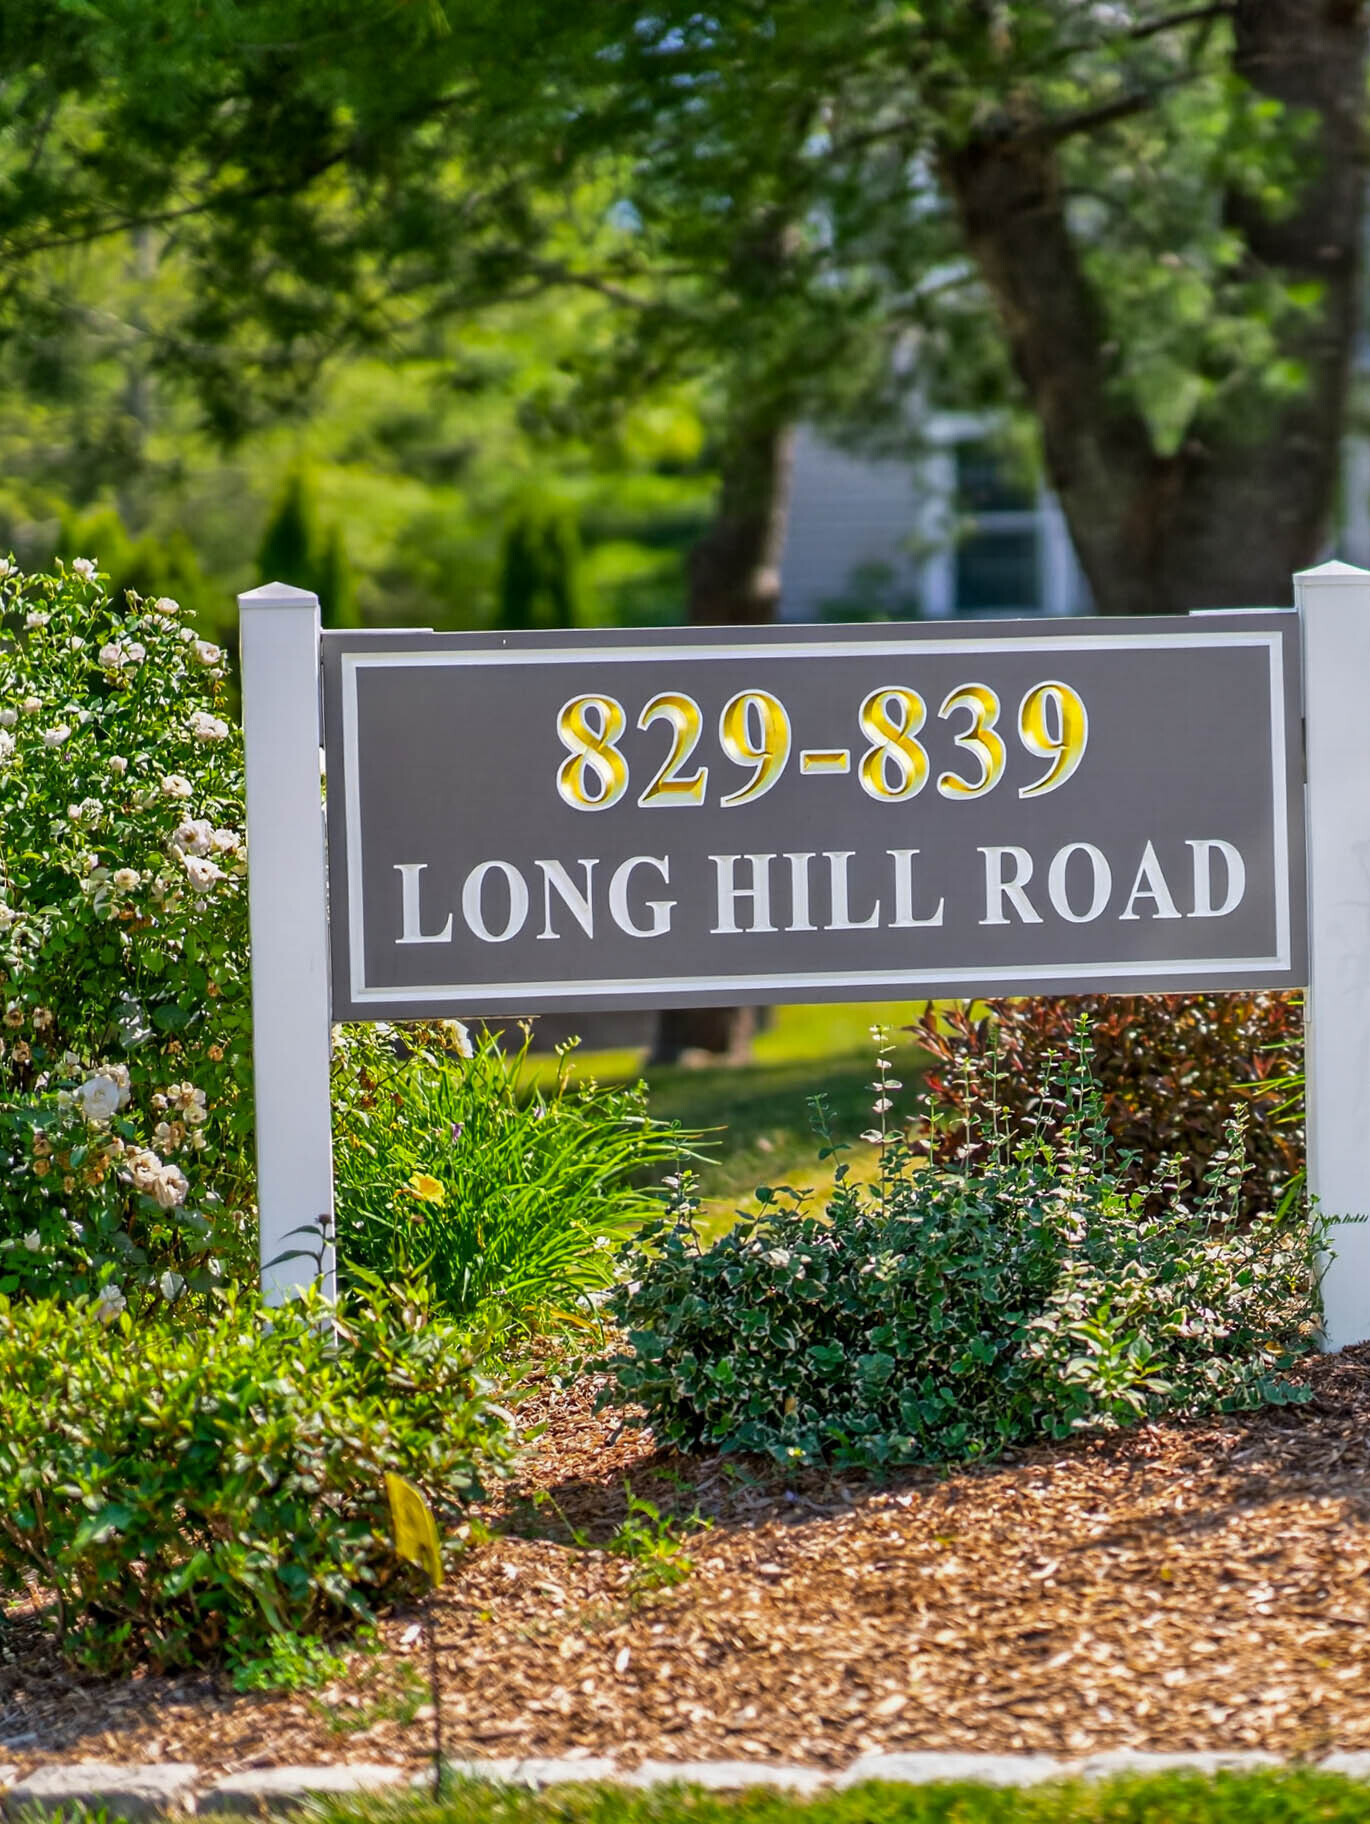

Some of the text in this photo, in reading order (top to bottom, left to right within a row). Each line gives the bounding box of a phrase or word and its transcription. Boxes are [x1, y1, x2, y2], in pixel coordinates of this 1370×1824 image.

[555, 679, 1089, 812] 829-839
[393, 838, 1247, 945] LONG HILL ROAD
